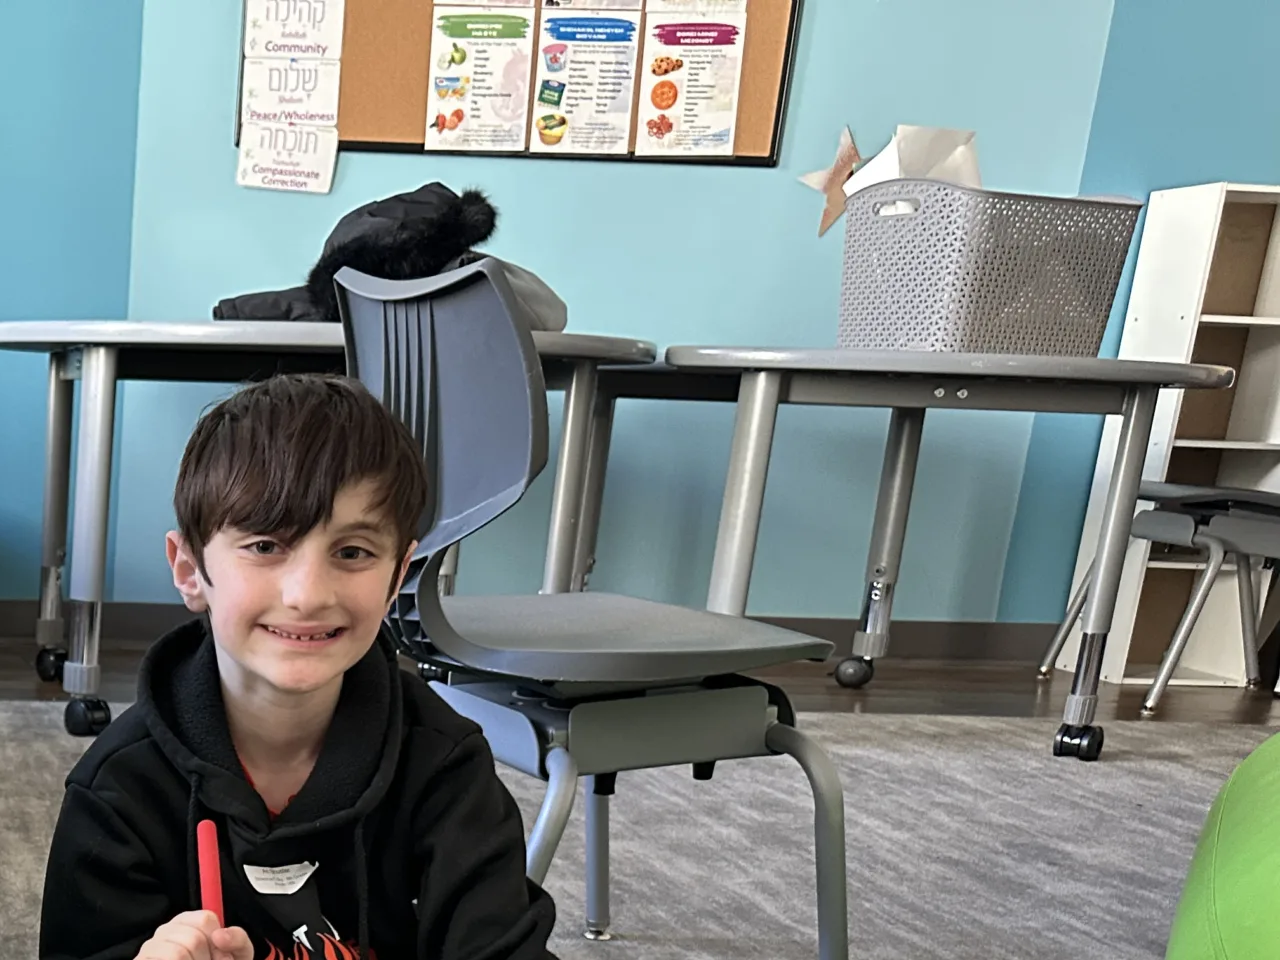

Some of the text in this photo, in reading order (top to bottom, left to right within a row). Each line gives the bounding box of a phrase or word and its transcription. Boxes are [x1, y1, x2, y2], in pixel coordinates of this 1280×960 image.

[265, 40, 328, 56] Community
[250, 110, 334, 121] Peace/Wholeness
[252, 164, 320, 179] Compassionate
[262, 176, 308, 188] Correction
